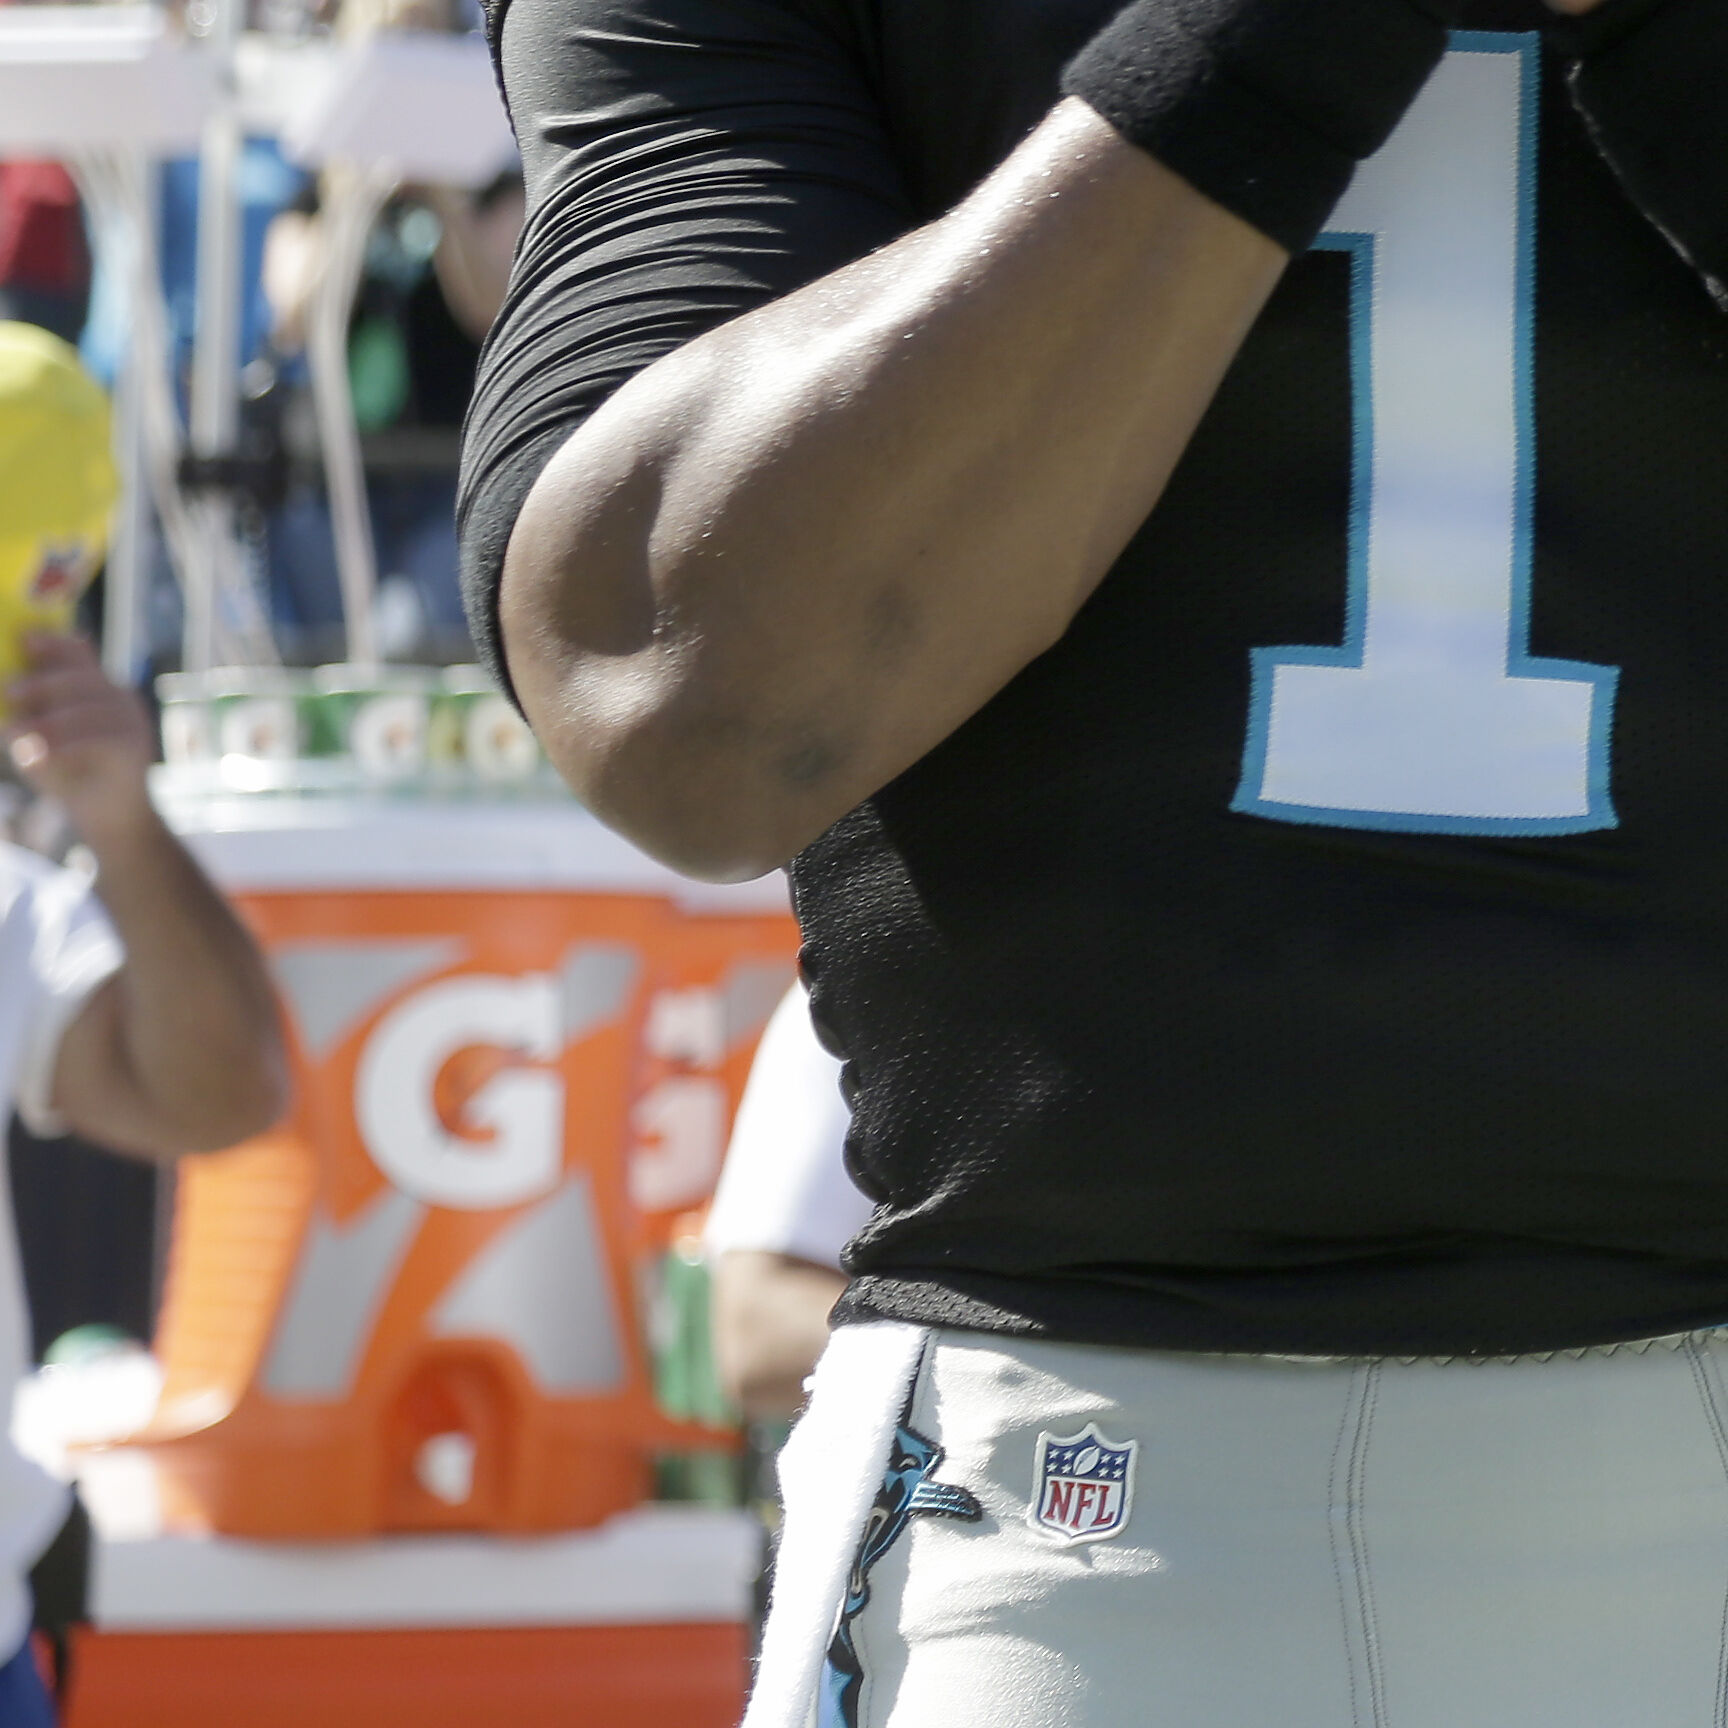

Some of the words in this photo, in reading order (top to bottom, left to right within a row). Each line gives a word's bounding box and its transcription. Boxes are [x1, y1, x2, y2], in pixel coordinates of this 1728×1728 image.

[1230, 30, 1621, 837] 1
[354, 970, 566, 1212] G
[1043, 1479, 1115, 1529] NFL
